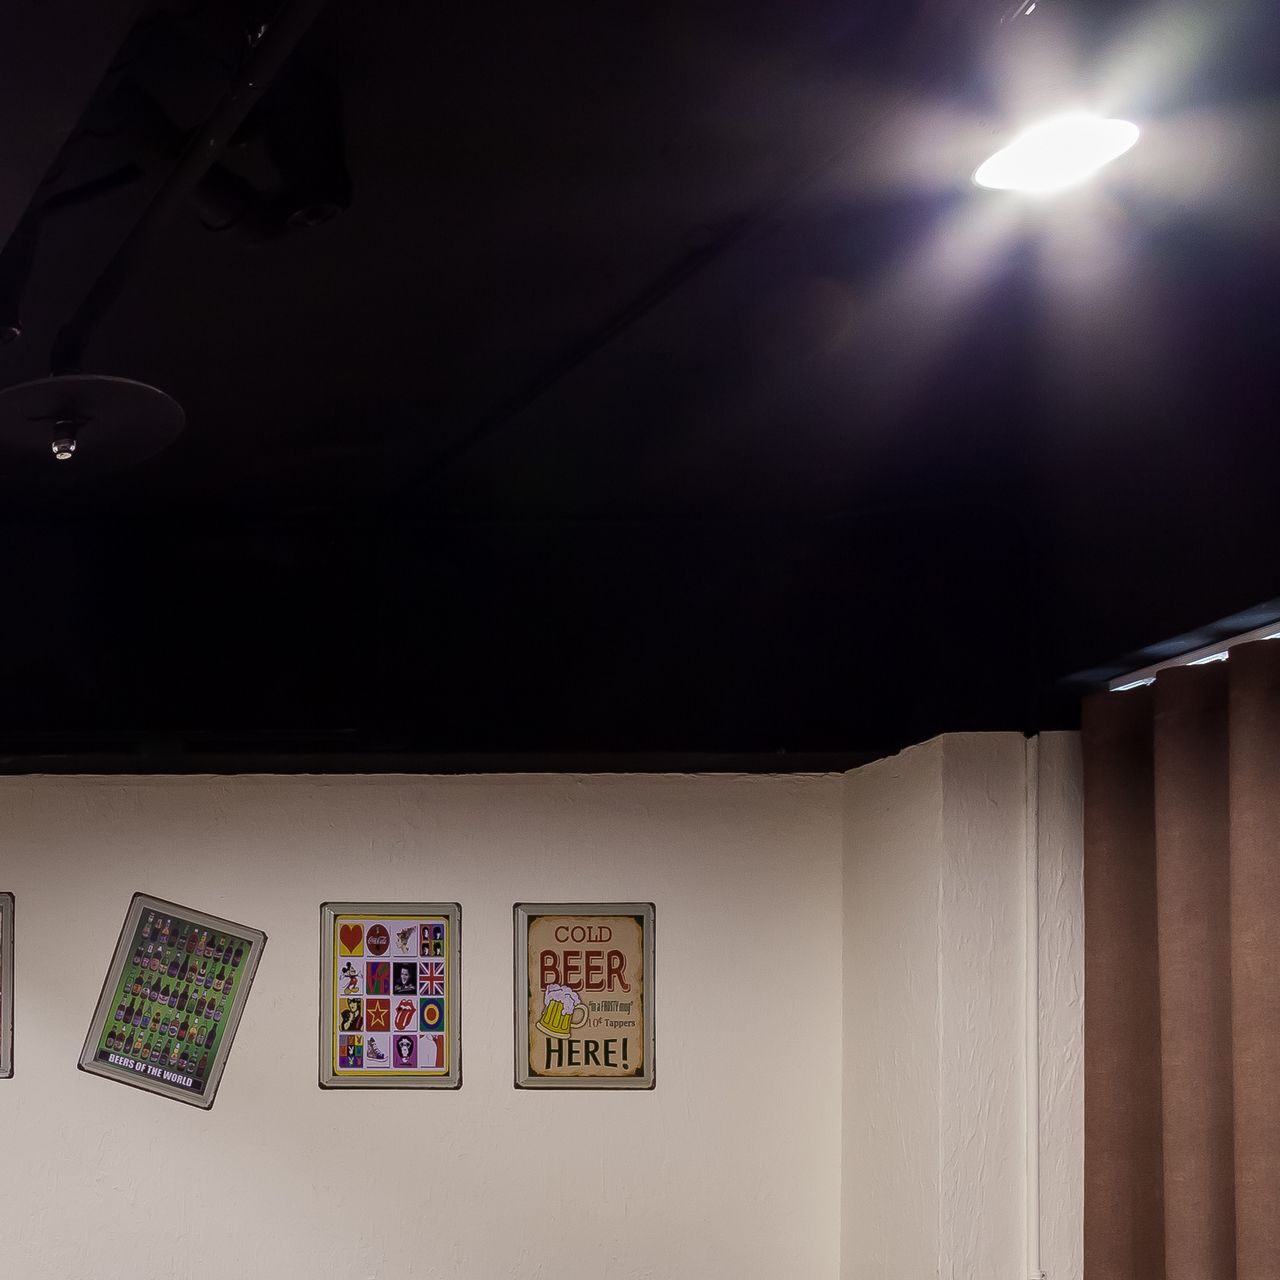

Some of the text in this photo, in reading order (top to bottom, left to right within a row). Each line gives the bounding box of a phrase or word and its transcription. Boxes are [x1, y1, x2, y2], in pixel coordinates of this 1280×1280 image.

[554, 926, 612, 943] COLD
[540, 950, 631, 992] BEER
[604, 1018, 636, 1029] Tappers
[545, 1038, 630, 1070] HERE!
[108, 1053, 193, 1088] BEERS OF THE WORLD
